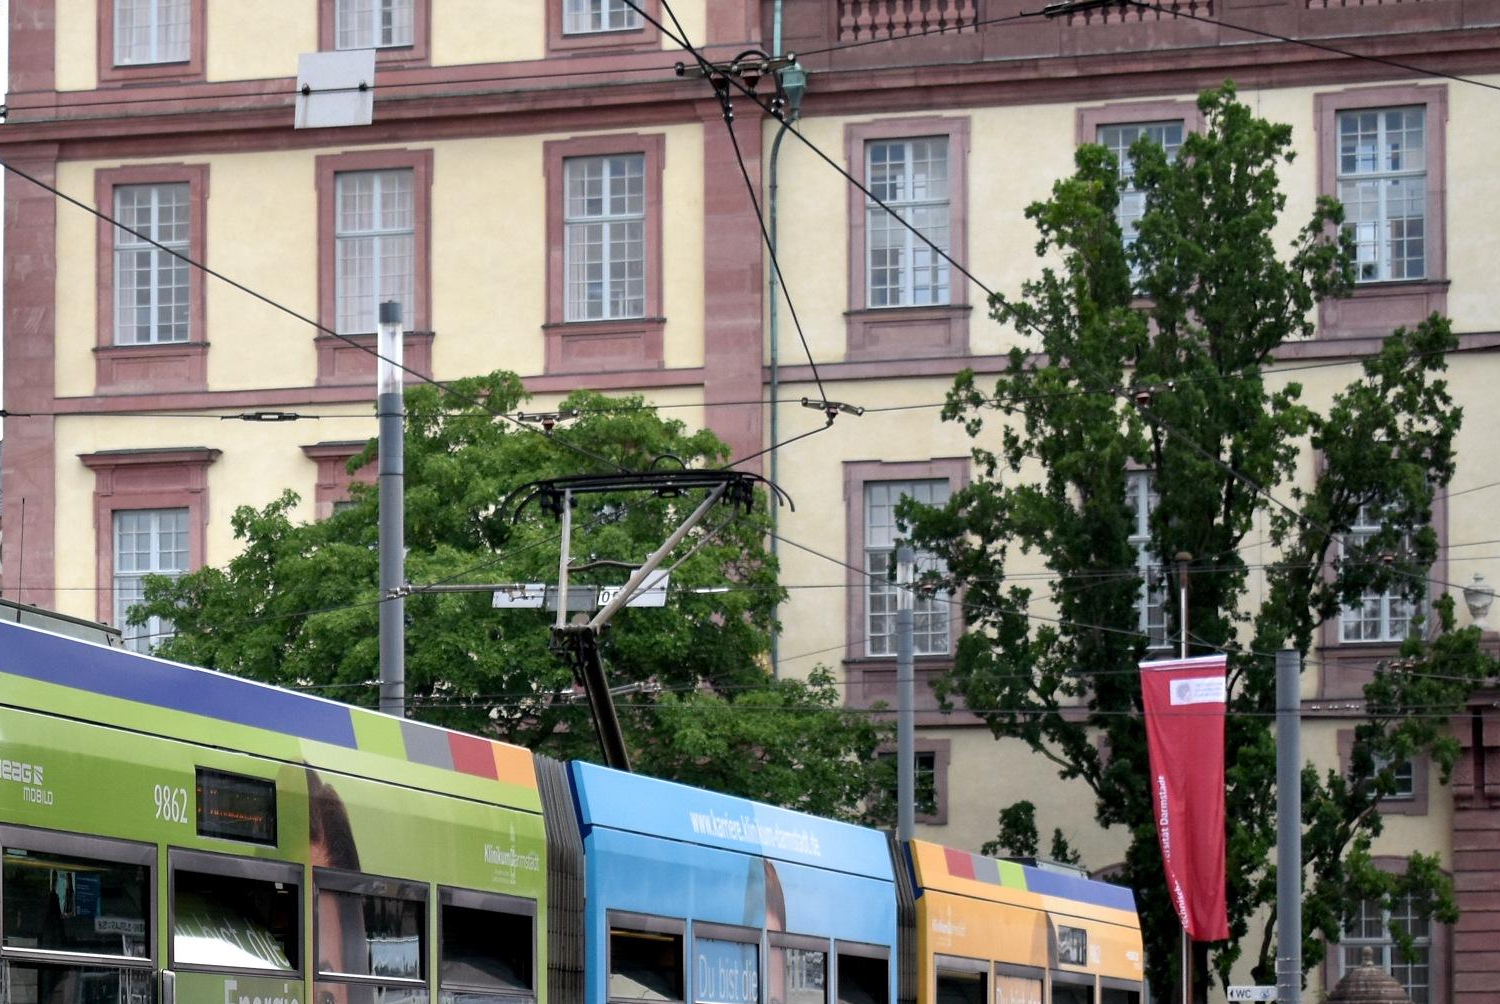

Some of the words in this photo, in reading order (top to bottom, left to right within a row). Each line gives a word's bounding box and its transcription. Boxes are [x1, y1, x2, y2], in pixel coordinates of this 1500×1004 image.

[154, 784, 188, 823] 9862
[1158, 775, 1169, 825] Darmstadt
[699, 955, 715, 999] Du
[719, 957, 739, 1001] bist
[742, 960, 758, 1002] die
[1236, 989, 1251, 999] WC
